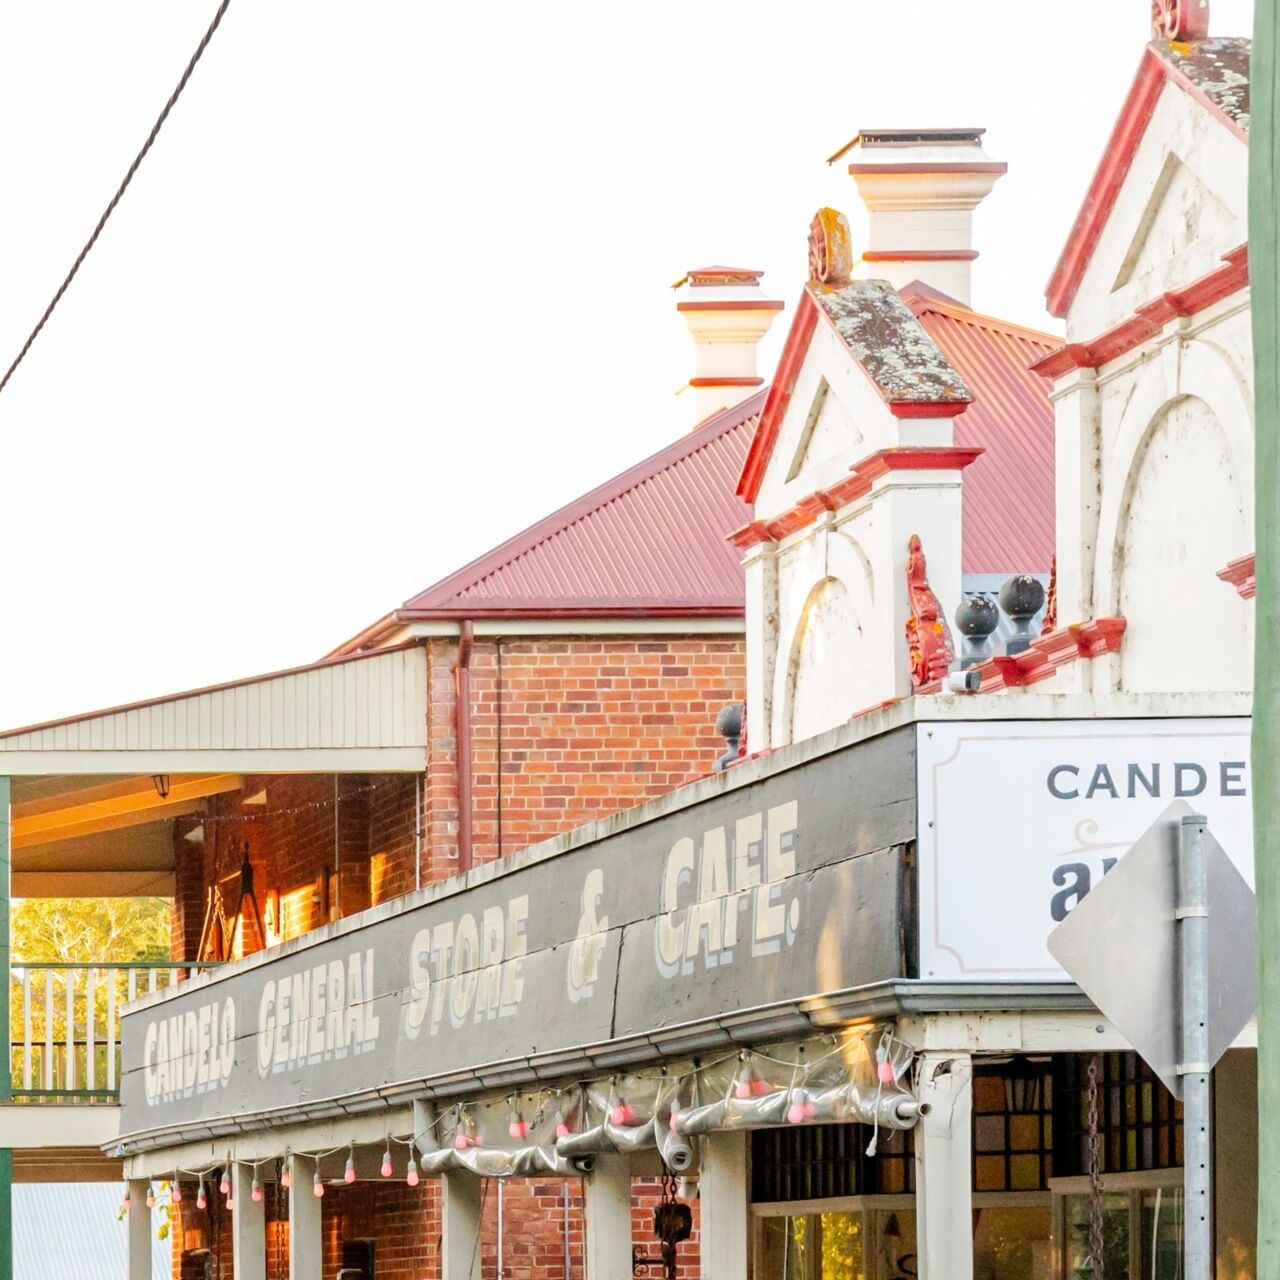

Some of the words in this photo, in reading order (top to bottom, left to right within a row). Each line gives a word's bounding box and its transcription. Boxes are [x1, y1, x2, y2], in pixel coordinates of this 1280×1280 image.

[1046, 760, 1248, 800] CANDE
[143, 996, 236, 1106] CANDELO
[257, 948, 380, 1079] GENERAL
[404, 893, 530, 1039] STORE
[566, 868, 609, 1004] &
